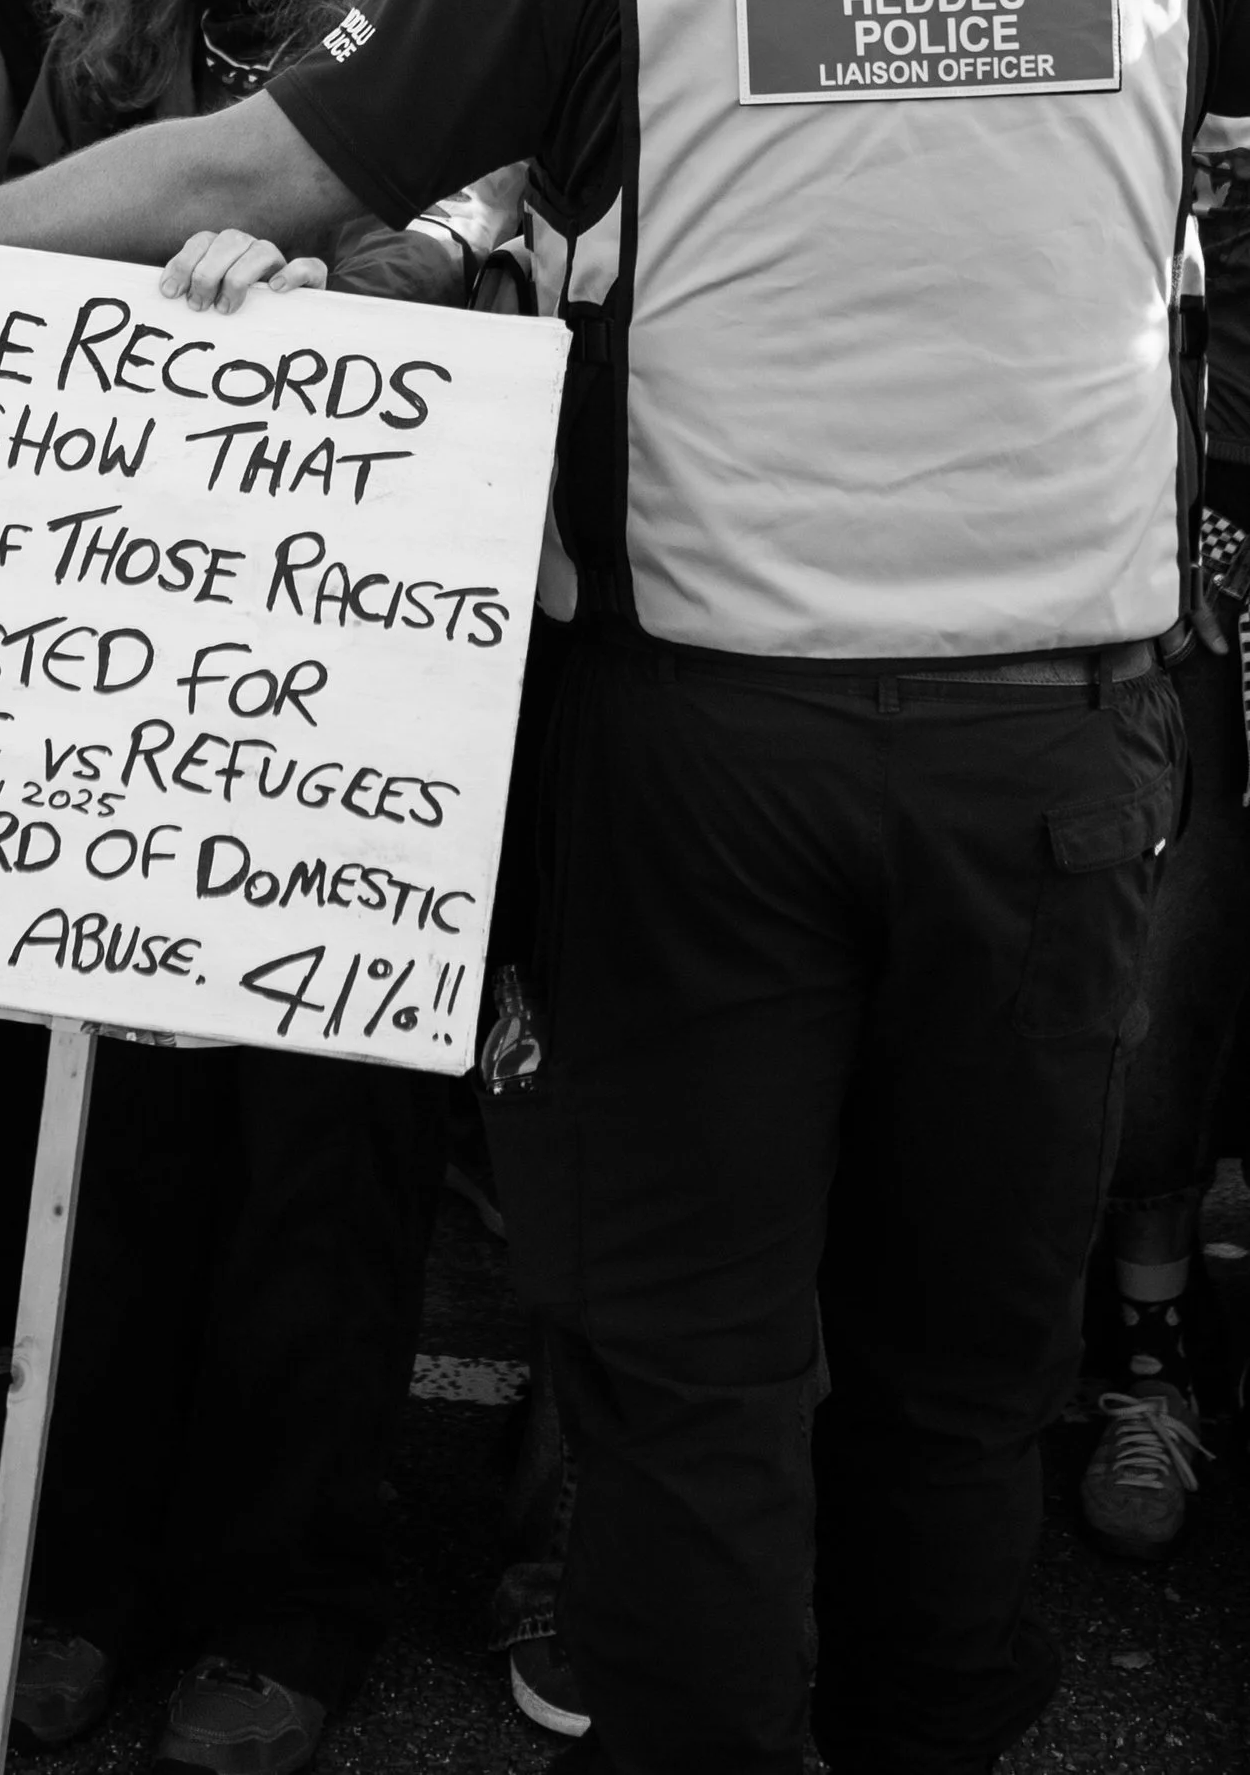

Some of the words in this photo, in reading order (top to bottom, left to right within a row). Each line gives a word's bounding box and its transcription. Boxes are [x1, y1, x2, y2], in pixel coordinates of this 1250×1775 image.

[819, 59, 929, 86] LIAISON
[938, 54, 1055, 81] OFFICER
[854, 15, 1020, 57] POLICE
[58, 298, 451, 429] RECORDS
[186, 422, 415, 504] THAT
[48, 505, 246, 604] THOSE
[267, 532, 509, 647] RACISTS
[177, 642, 328, 726] FOR
[21, 781, 126, 817] 2025
[121, 719, 460, 826] REFUGEES
[85, 825, 182, 880] OF
[196, 835, 476, 934] DOMESTIC
[8, 908, 206, 985] ABUSE.
